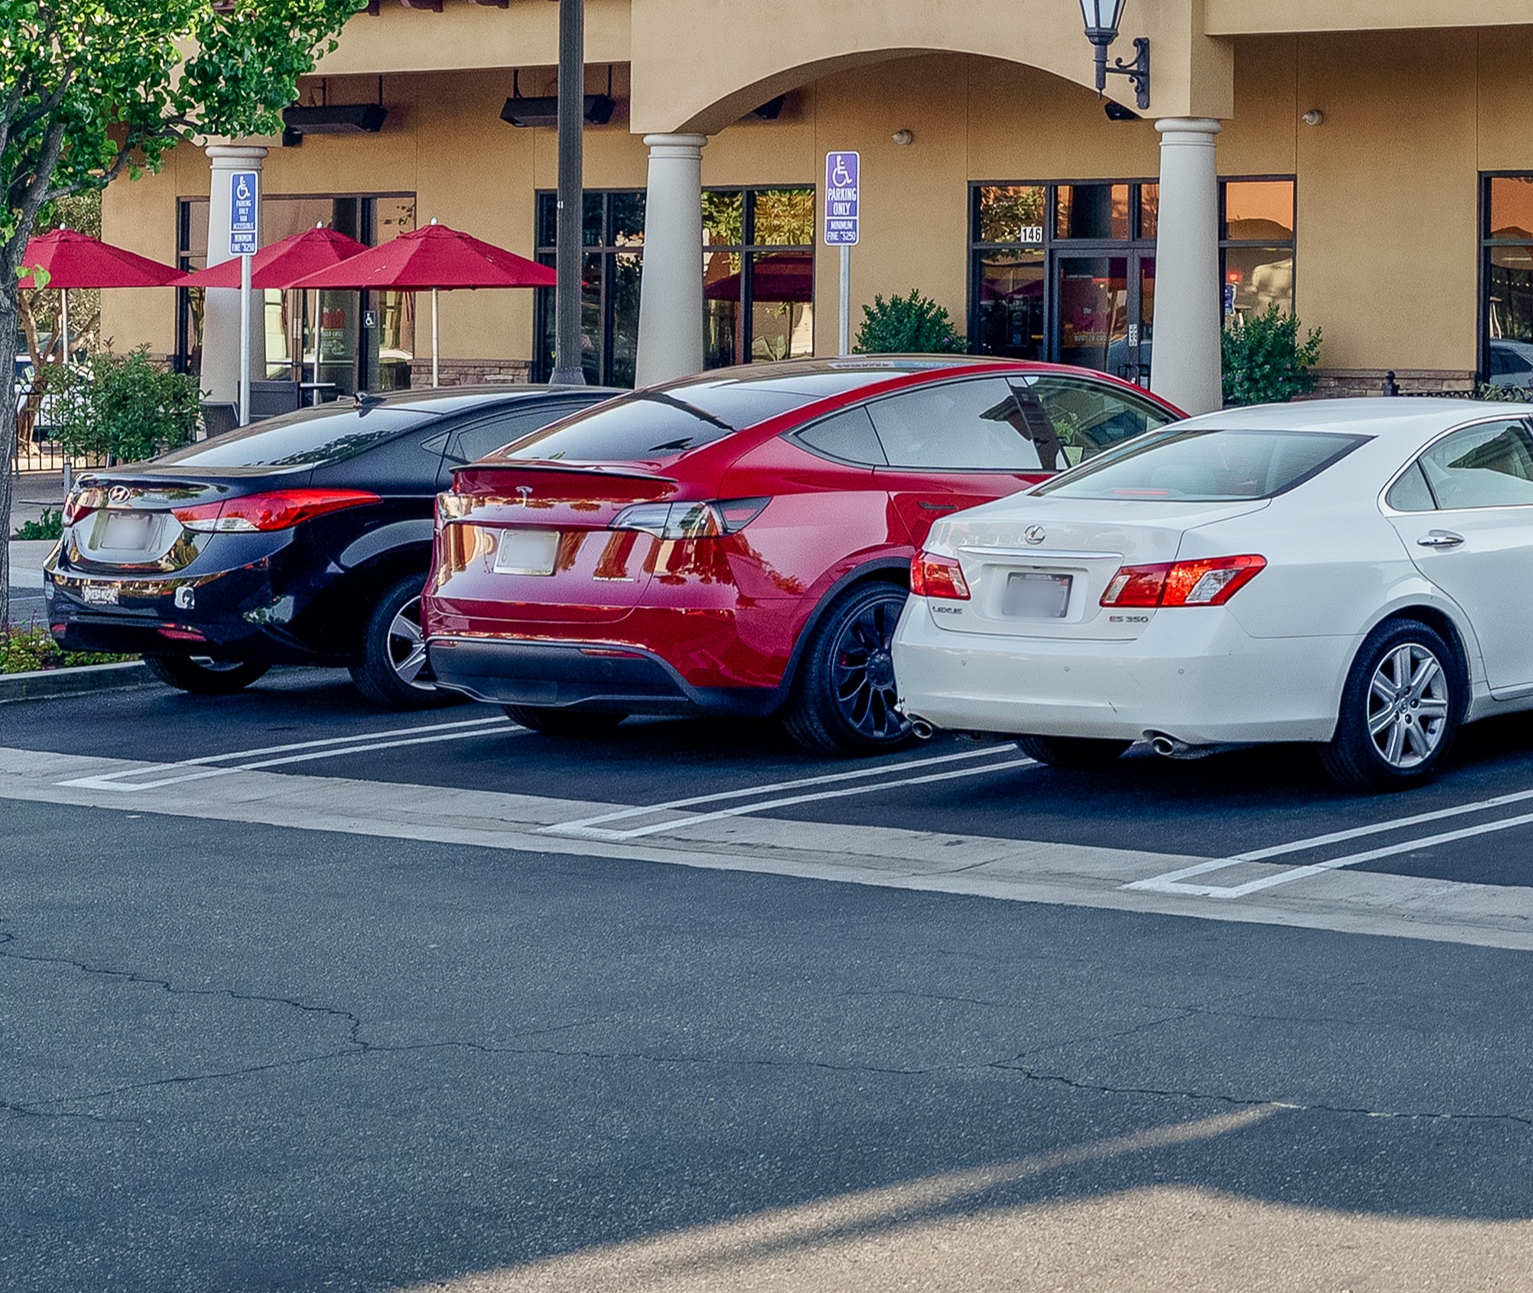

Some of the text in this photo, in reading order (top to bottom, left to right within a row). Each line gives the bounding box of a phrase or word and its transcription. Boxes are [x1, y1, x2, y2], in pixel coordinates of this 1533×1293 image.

[828, 187, 857, 202] PARKING
[833, 202, 851, 216] ONLY
[1023, 228, 1041, 242] 146
[1125, 615, 1149, 623] 350
